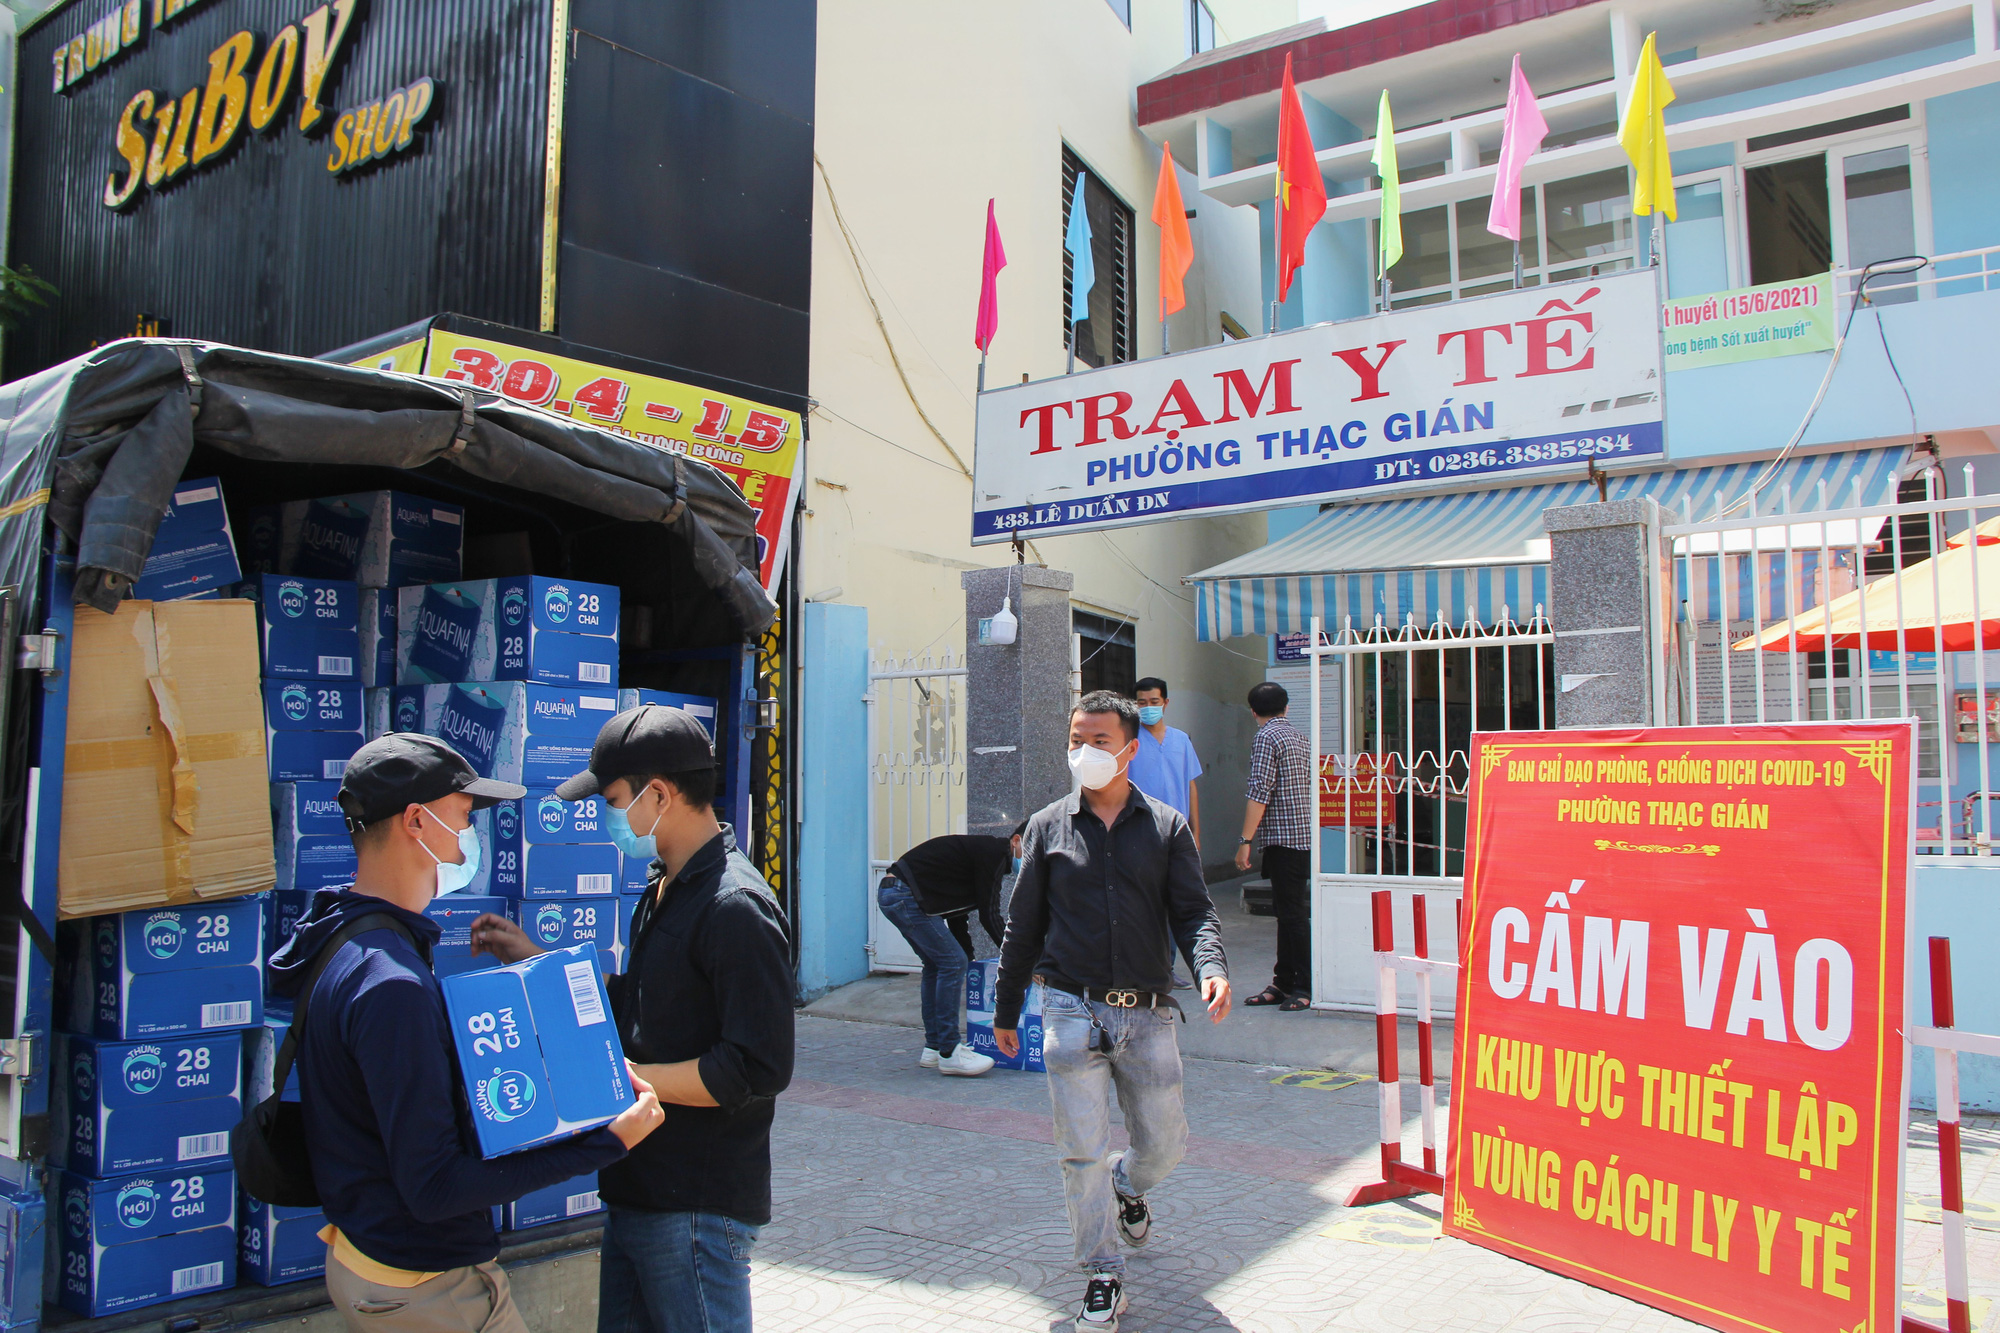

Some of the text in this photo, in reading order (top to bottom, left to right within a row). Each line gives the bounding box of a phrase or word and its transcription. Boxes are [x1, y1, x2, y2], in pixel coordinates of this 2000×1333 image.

[52, 0, 141, 93] TRUNG
[326, 76, 435, 177] SHOP
[1674, 285, 1818, 325] huyết (15/6/2021)
[1664, 341, 1687, 355] òng
[1690, 335, 1718, 353] bệnh
[1721, 330, 1740, 347] Sốt
[1744, 325, 1769, 343] xuất
[1019, 287, 1602, 457] TRẠM Y TẾ
[443, 347, 629, 423] 30.4
[692, 398, 788, 453] 1.5
[1086, 398, 1495, 487] PHƯỜNG THẠC GIÁN
[692, 443, 744, 465] BỪNG
[1374, 433, 1634, 481] ĐT: 0236.3835284
[1067, 494, 1132, 521] DUẨN
[1137, 491, 1171, 512] ĐN
[396, 507, 431, 528] AQUAFINA
[302, 520, 360, 563] AQUAFINA
[314, 588, 338, 606] 28
[578, 593, 600, 613] 28
[316, 608, 339, 618] CHAI
[578, 614, 599, 625] CHAI
[1940, 608, 1992, 621] HOUE
[418, 607, 471, 658] AQUAFINA
[504, 637, 524, 656] 28
[504, 658, 523, 668] CHAI
[318, 690, 342, 707] 28
[533, 700, 577, 718] AQUAFINA
[320, 710, 343, 719] CHAI
[440, 705, 495, 761] AQUAFINA
[1507, 751, 1846, 790] BAN CHỈ ĐẠO PHÒNG, CHỐNG DỊCH COVID-19
[303, 799, 344, 815] AQUAFIN
[574, 800, 598, 818] 28
[1557, 795, 1769, 832] PHƯỜNG THẠC GIÁN
[575, 821, 598, 831] CHAI
[498, 850, 516, 871] 28
[498, 872, 516, 884] CHAI
[196, 915, 230, 938] 28
[573, 908, 597, 927] 28
[573, 929, 596, 940] CHAI
[197, 941, 229, 954] CHAI
[1488, 879, 1855, 1052] CẤM VÀO
[100, 981, 116, 1006] 28
[969, 990, 980, 1000] 28
[101, 1008, 116, 1023] CHAI
[468, 1011, 502, 1057] 28
[498, 1006, 521, 1049] CHAI
[972, 1032, 998, 1048] AQUA
[176, 1047, 210, 1072] 28
[1028, 1047, 1041, 1057] 28
[177, 1073, 209, 1088] CHAI
[475, 1079, 497, 1120] THÙNG
[503, 1077, 523, 1110] MỚI
[1475, 1033, 1858, 1181] KHU VỰC THIẾT LẬP
[76, 1114, 93, 1140] 28
[76, 1141, 93, 1157] CHAI
[170, 1176, 204, 1202] 28
[171, 1202, 204, 1218] CHAI
[1471, 1126, 1860, 1301] VÙNG CÁCH LY Y TẾ
[243, 1225, 261, 1250] 28
[67, 1251, 87, 1278] 28
[243, 1250, 260, 1266] CHAI
[67, 1278, 87, 1295] CHAI
